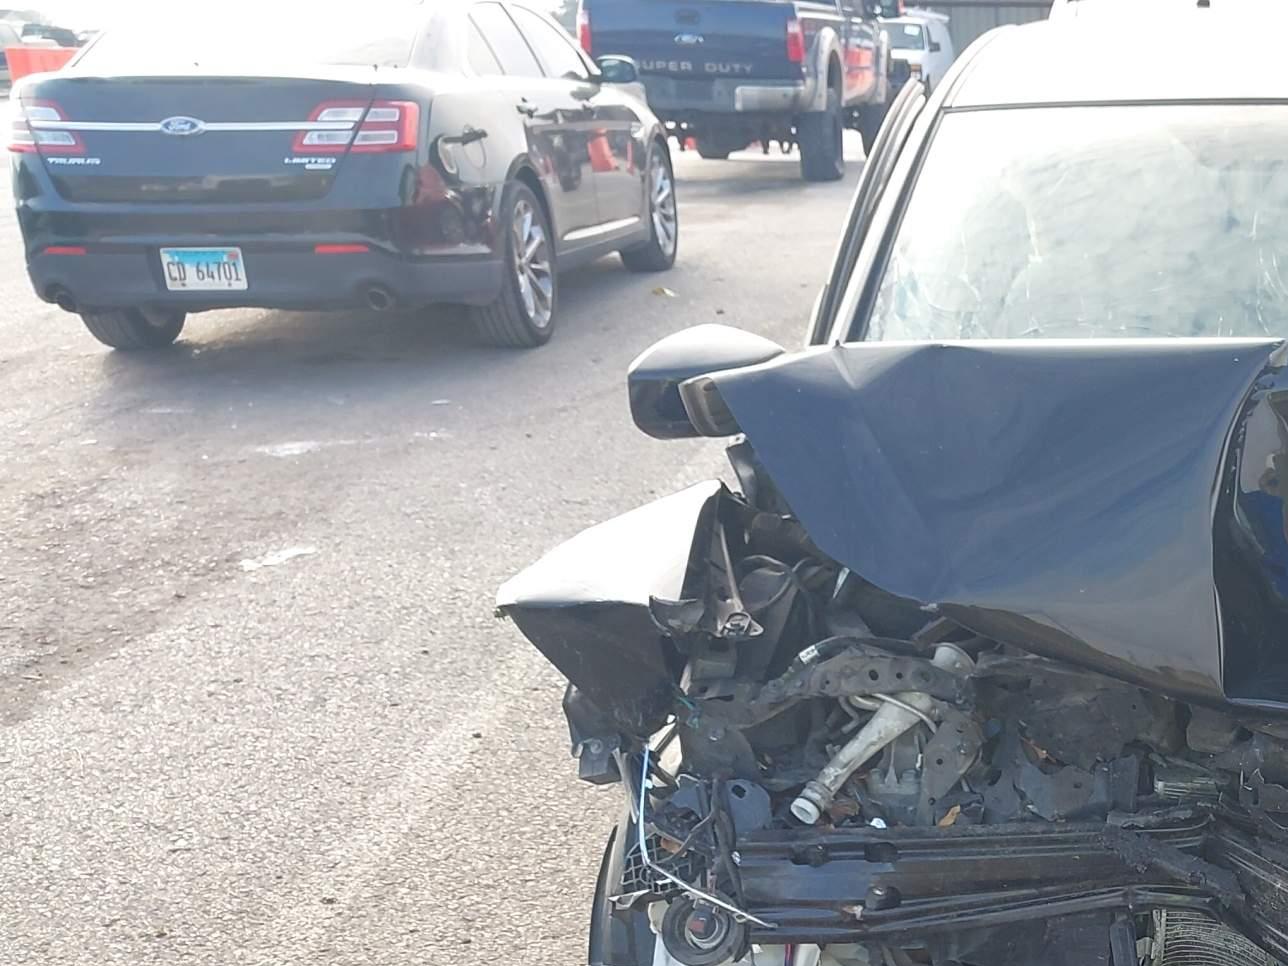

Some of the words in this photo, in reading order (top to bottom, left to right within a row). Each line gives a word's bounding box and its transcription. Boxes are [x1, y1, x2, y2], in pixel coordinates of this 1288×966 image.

[705, 62, 752, 73] DUTY
[166, 261, 187, 282] CD
[195, 261, 242, 282] 64701
